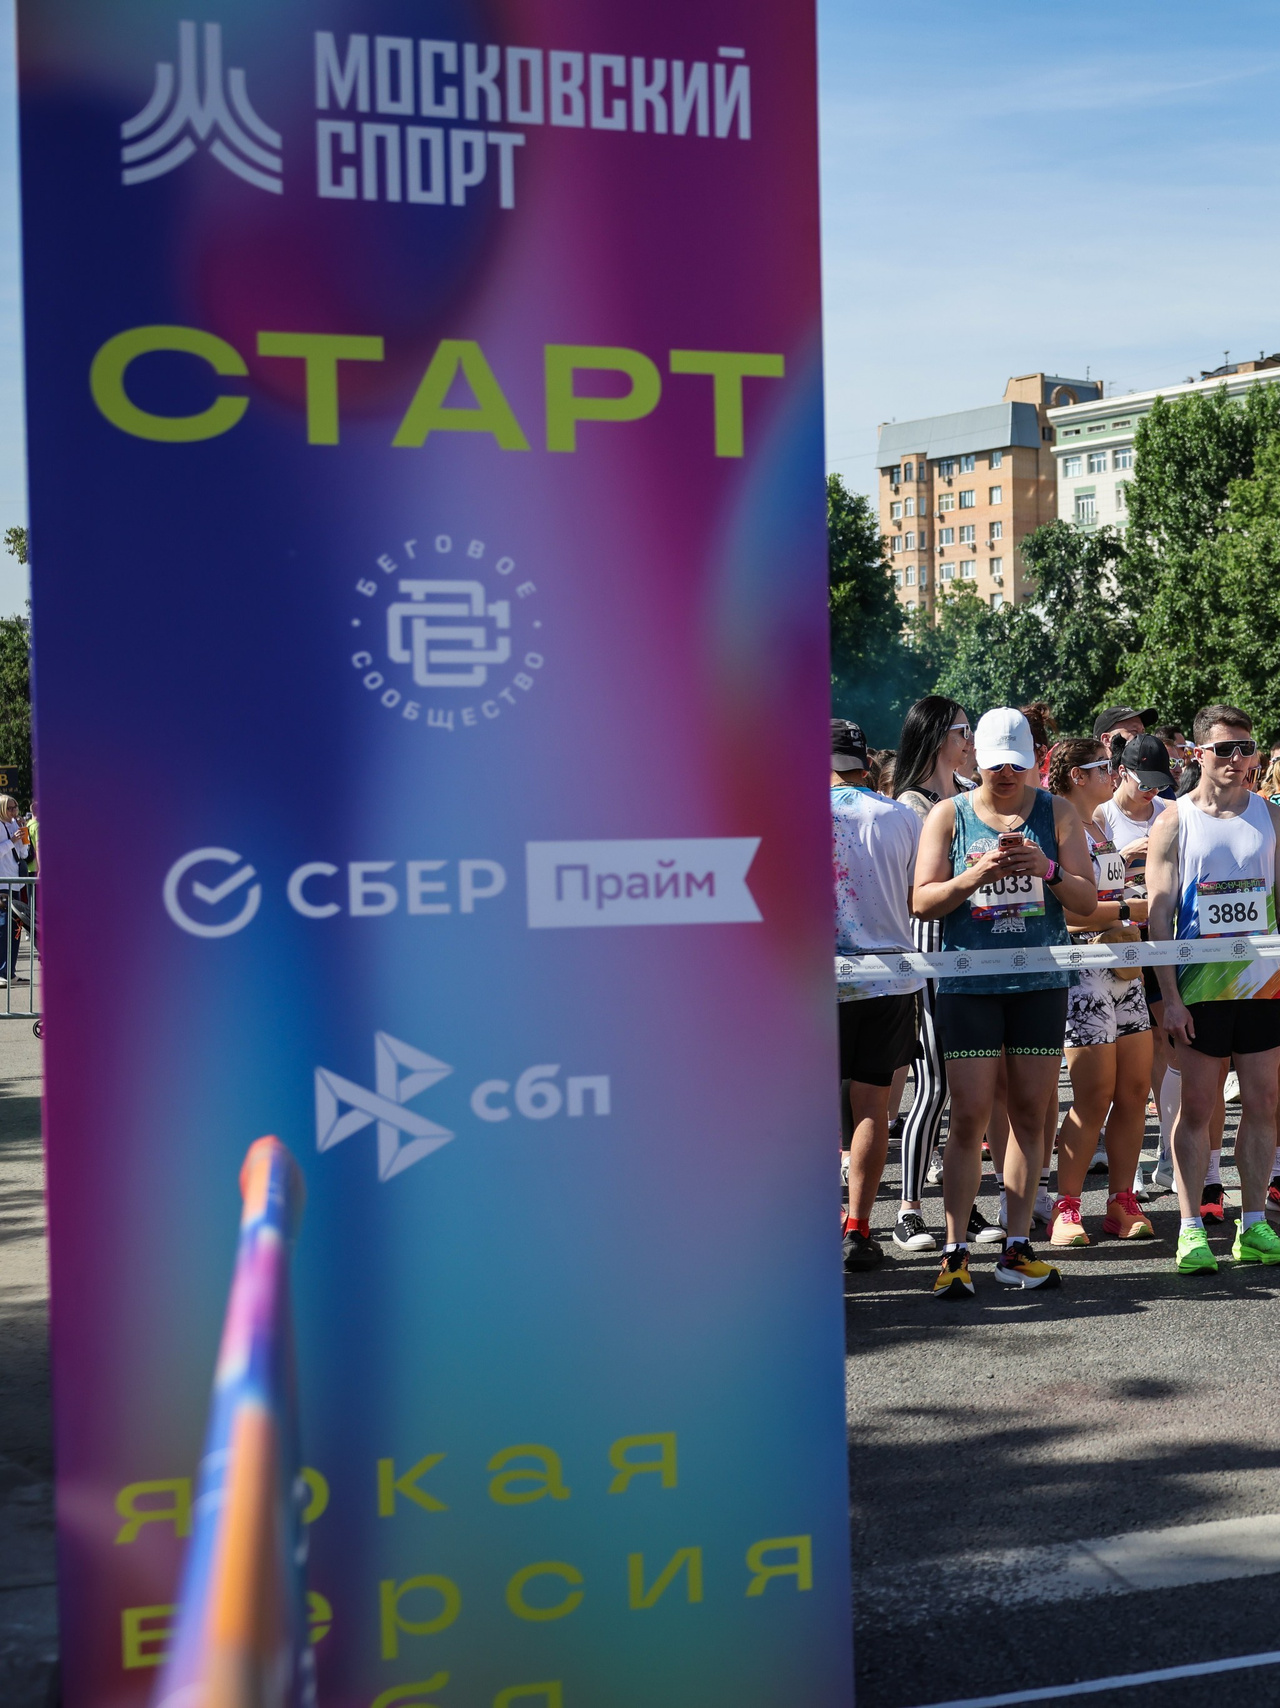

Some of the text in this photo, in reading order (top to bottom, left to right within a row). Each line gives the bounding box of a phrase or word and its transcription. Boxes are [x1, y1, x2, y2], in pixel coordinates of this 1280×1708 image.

[314, 31, 751, 140] МОСКОВСКИЙ
[316, 119, 526, 209] СПОРТ
[89, 324, 785, 458] СТАРТ
[355, 534, 537, 598] БЕГОВОЕ
[351, 650, 545, 732] СООБЩЕСТВО
[286, 858, 716, 919] СБЕР Прайм
[978, 875, 1033, 896] 4033
[1208, 901, 1258, 924] 3886
[469, 1064, 611, 1122] сбп
